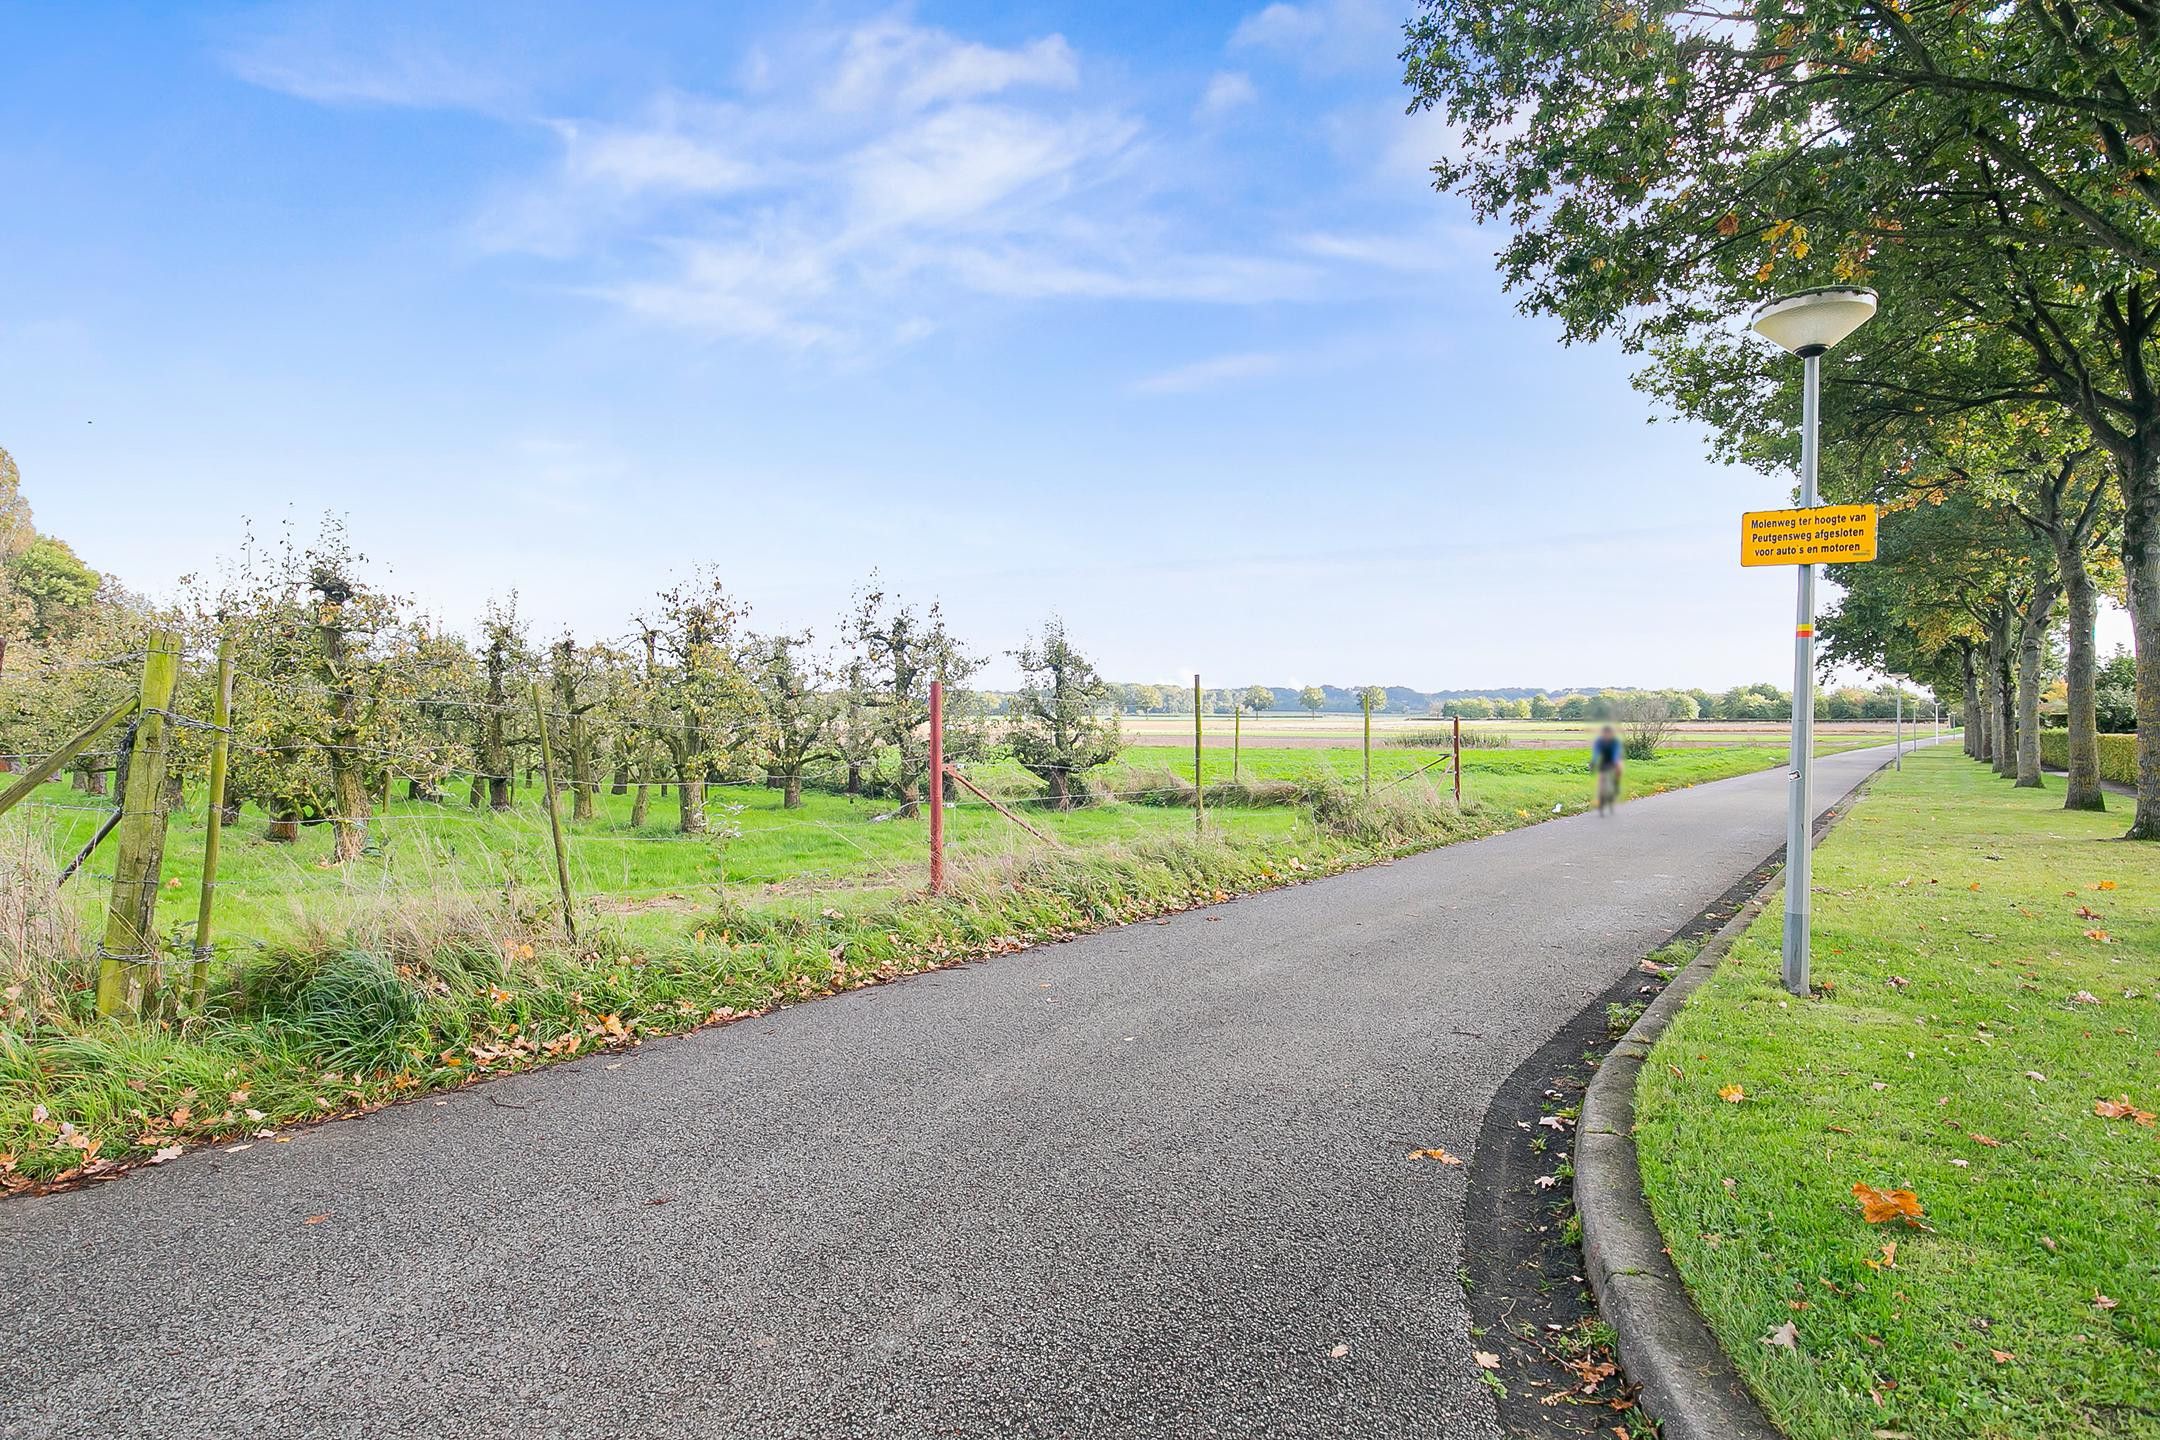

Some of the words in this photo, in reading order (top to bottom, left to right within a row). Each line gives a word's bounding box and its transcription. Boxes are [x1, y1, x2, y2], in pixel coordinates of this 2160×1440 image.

[1751, 519, 1796, 529] Molenweg
[1799, 518, 1811, 526] ter
[1815, 514, 1846, 525] hoogte
[1850, 513, 1866, 522] van
[1752, 532, 1812, 544] Peutgensweg
[1815, 528, 1864, 541] afgesloten
[1755, 548, 1774, 557] voor
[1807, 545, 1818, 554] en
[1821, 543, 1860, 554] motoren
